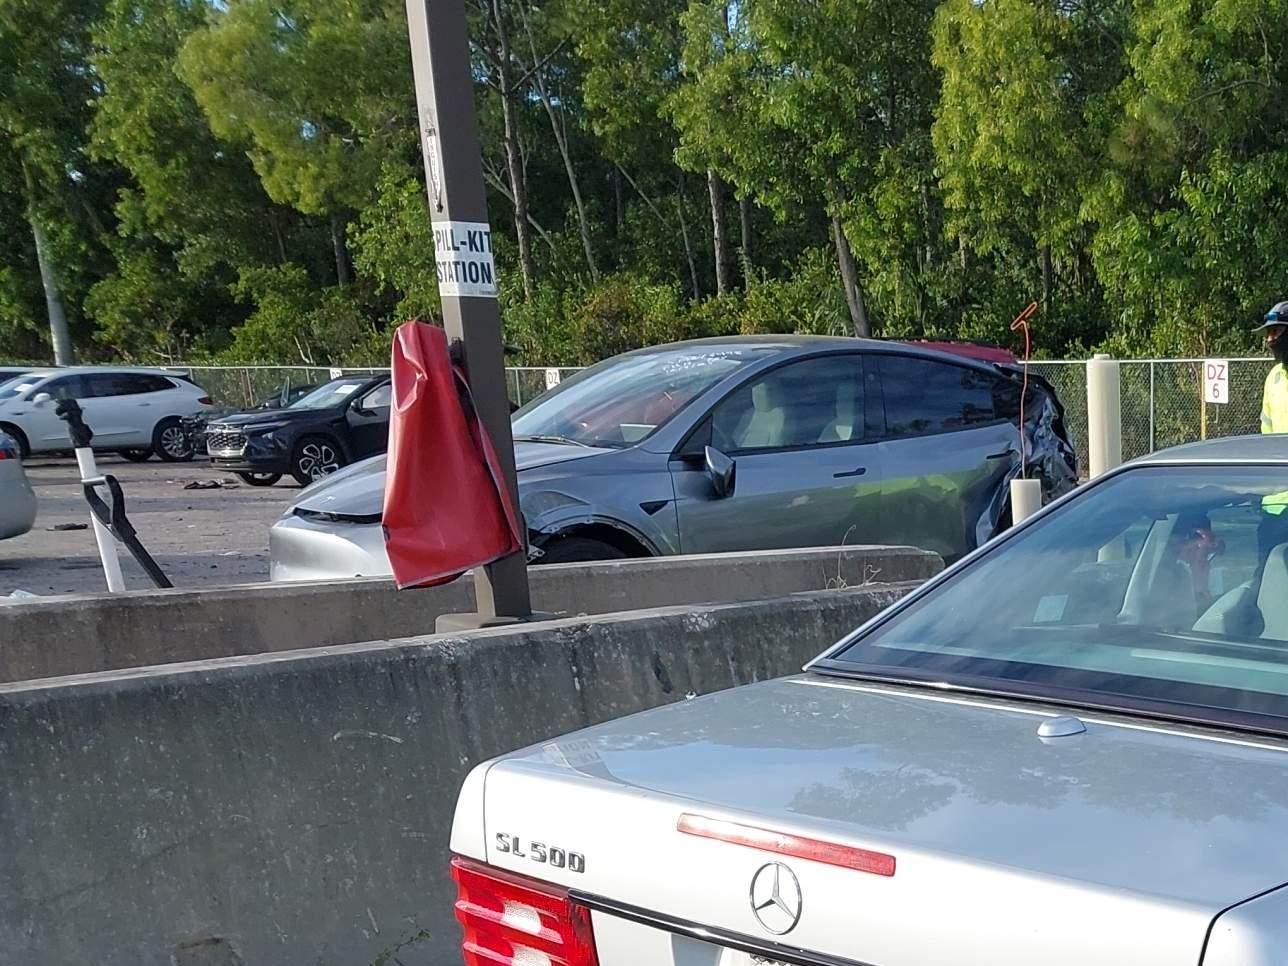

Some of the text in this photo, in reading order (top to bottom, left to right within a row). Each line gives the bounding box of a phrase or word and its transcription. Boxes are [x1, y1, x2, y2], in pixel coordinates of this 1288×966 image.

[435, 229, 492, 253] PILL-KIT
[436, 260, 492, 284] STATION
[1207, 364, 1226, 381] DZ
[1212, 382, 1220, 399] 6
[495, 832, 585, 873] SL 500
